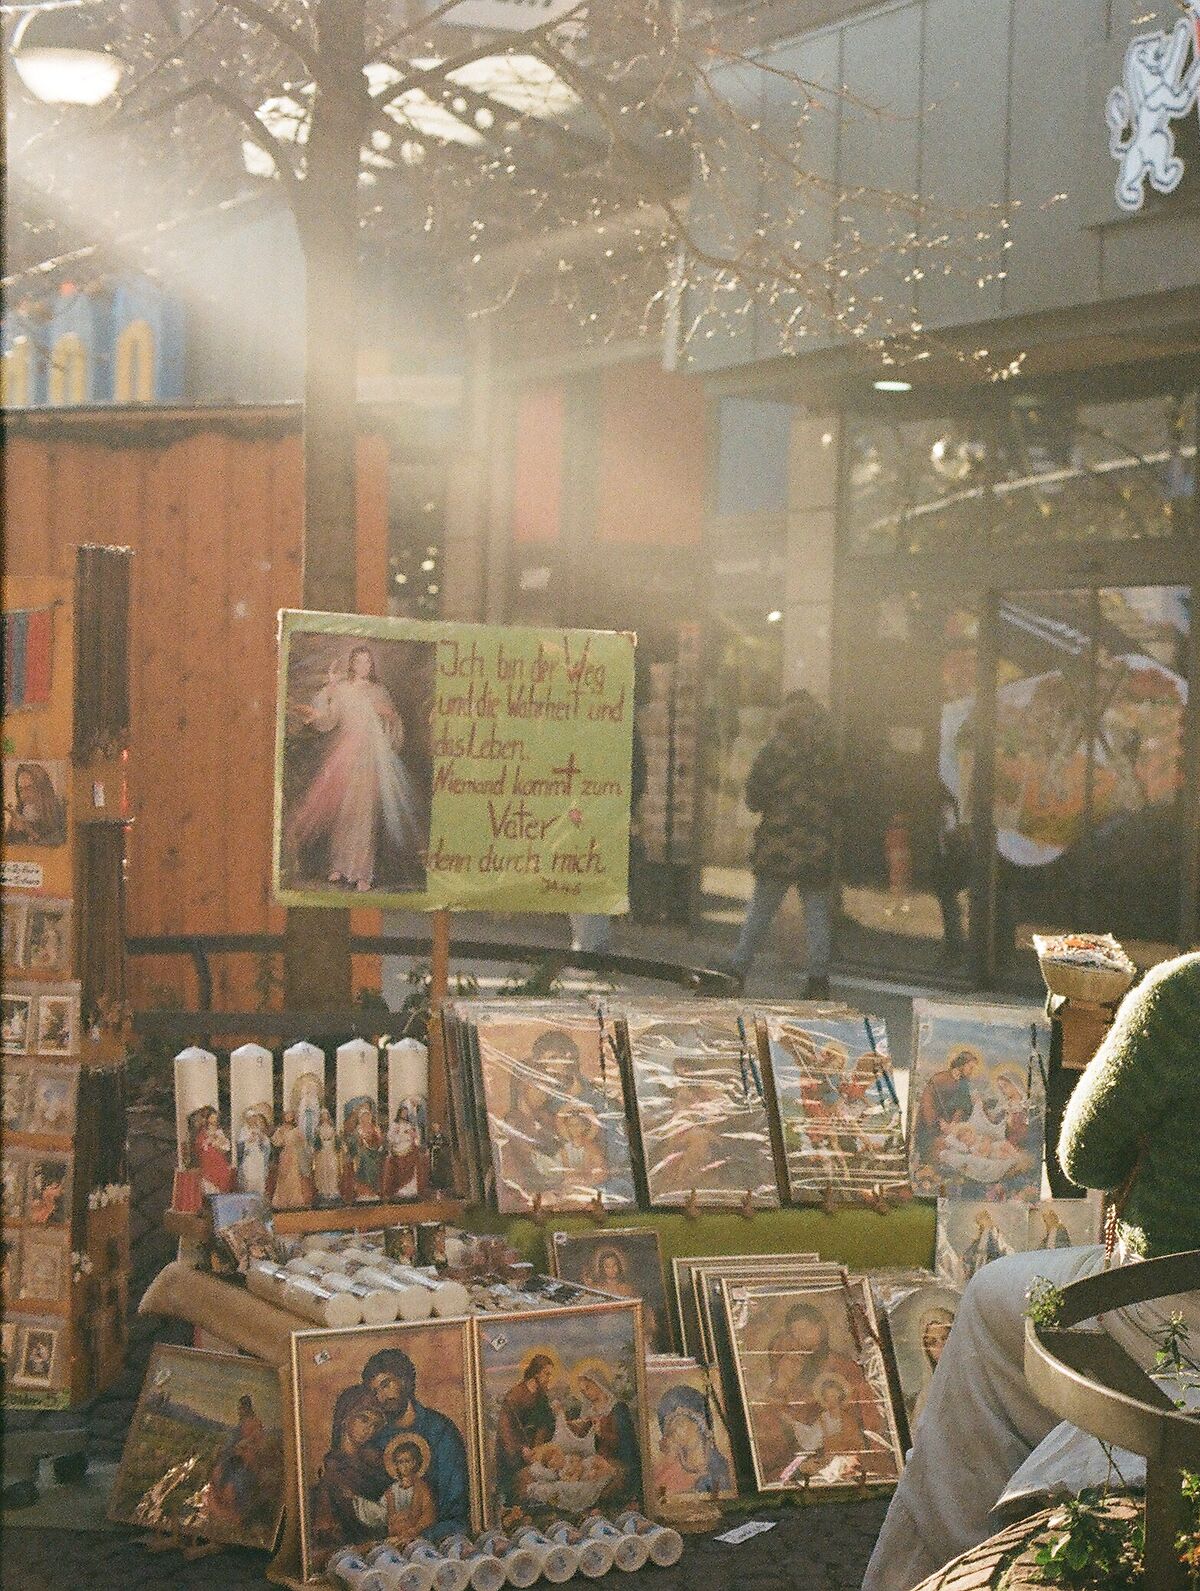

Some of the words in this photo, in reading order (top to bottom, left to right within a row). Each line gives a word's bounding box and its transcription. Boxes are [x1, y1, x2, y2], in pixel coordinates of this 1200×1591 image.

[439, 639, 485, 677] Ich
[563, 635, 606, 696] Weg
[586, 682, 626, 723] und
[511, 752, 582, 797] kommt
[487, 800, 562, 840] Vater
[479, 843, 541, 873] durch
